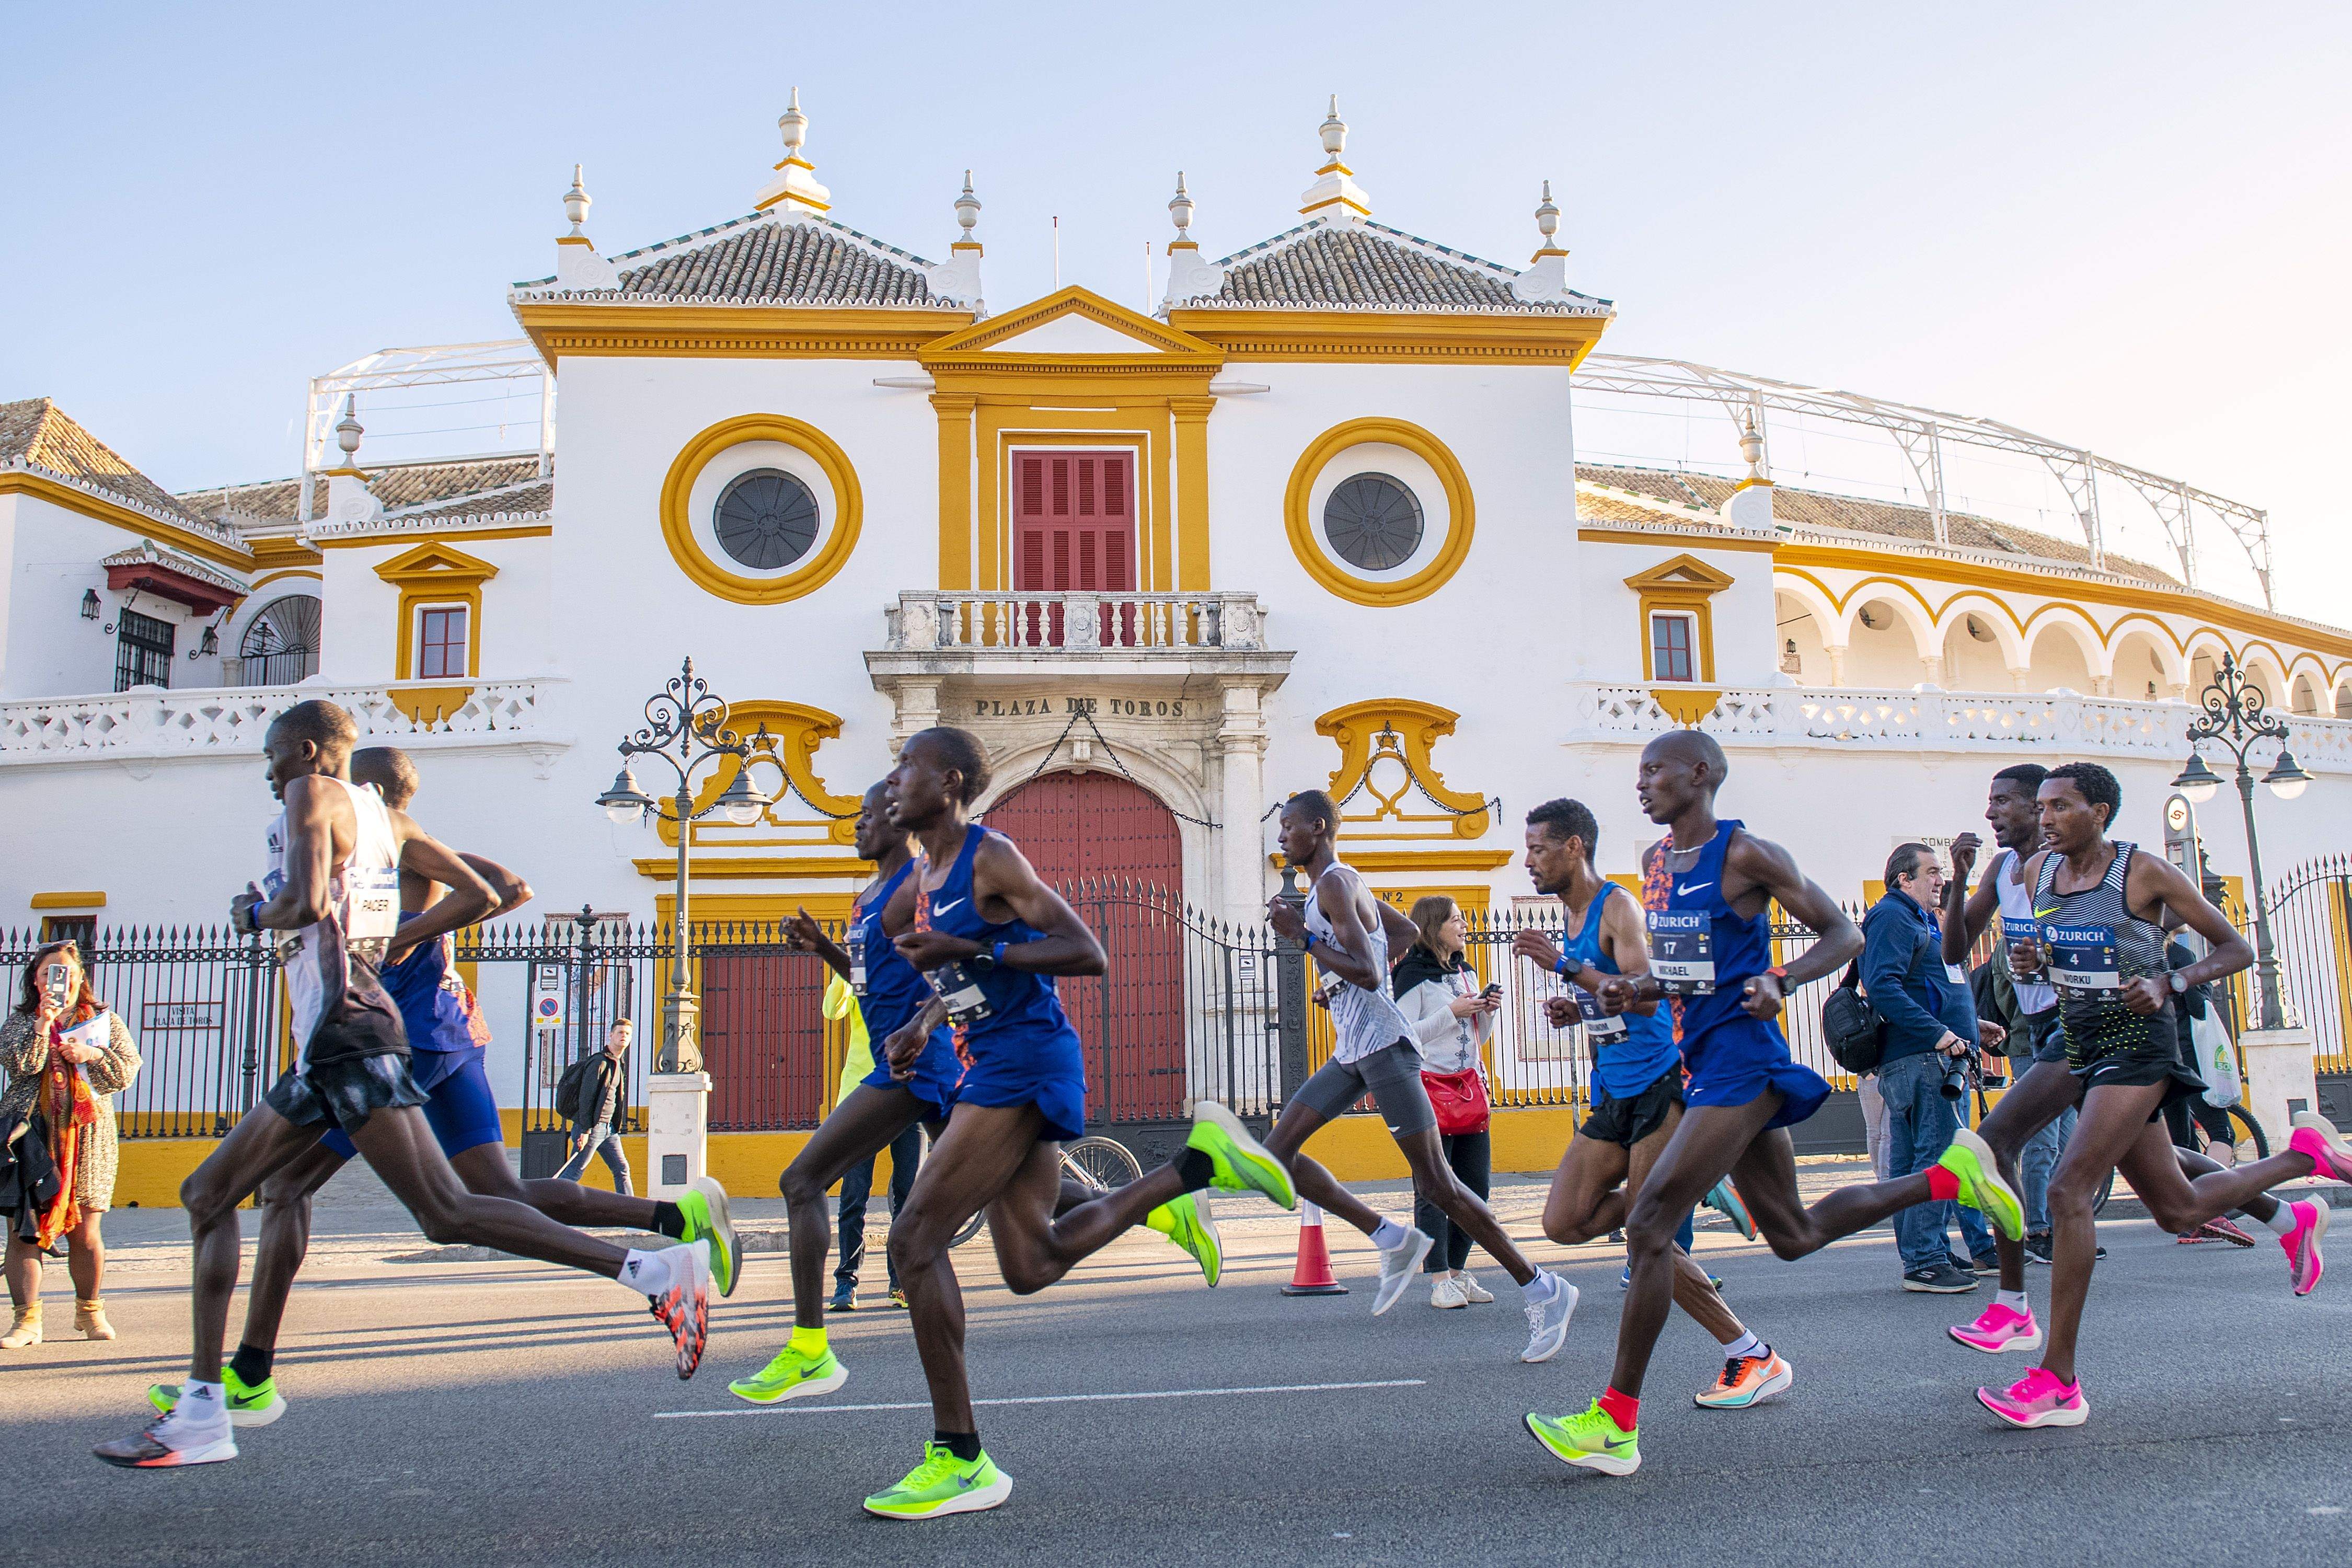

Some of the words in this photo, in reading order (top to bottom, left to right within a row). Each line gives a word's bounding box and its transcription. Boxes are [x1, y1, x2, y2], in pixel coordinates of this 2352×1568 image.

[975, 698, 1052, 716] PLAZA
[1066, 697, 1097, 713] DE
[1110, 699, 1183, 717] TOROS
[1396, 892, 1403, 902] 2
[361, 899, 388, 912] PACER
[1658, 916, 1699, 927] ZURICH
[2005, 922, 2038, 932] ZURICH
[2059, 931, 2104, 941] ZURICH
[1663, 941, 1677, 955] 17
[2069, 953, 2079, 965] 4
[2063, 973, 2091, 985] WORKU
